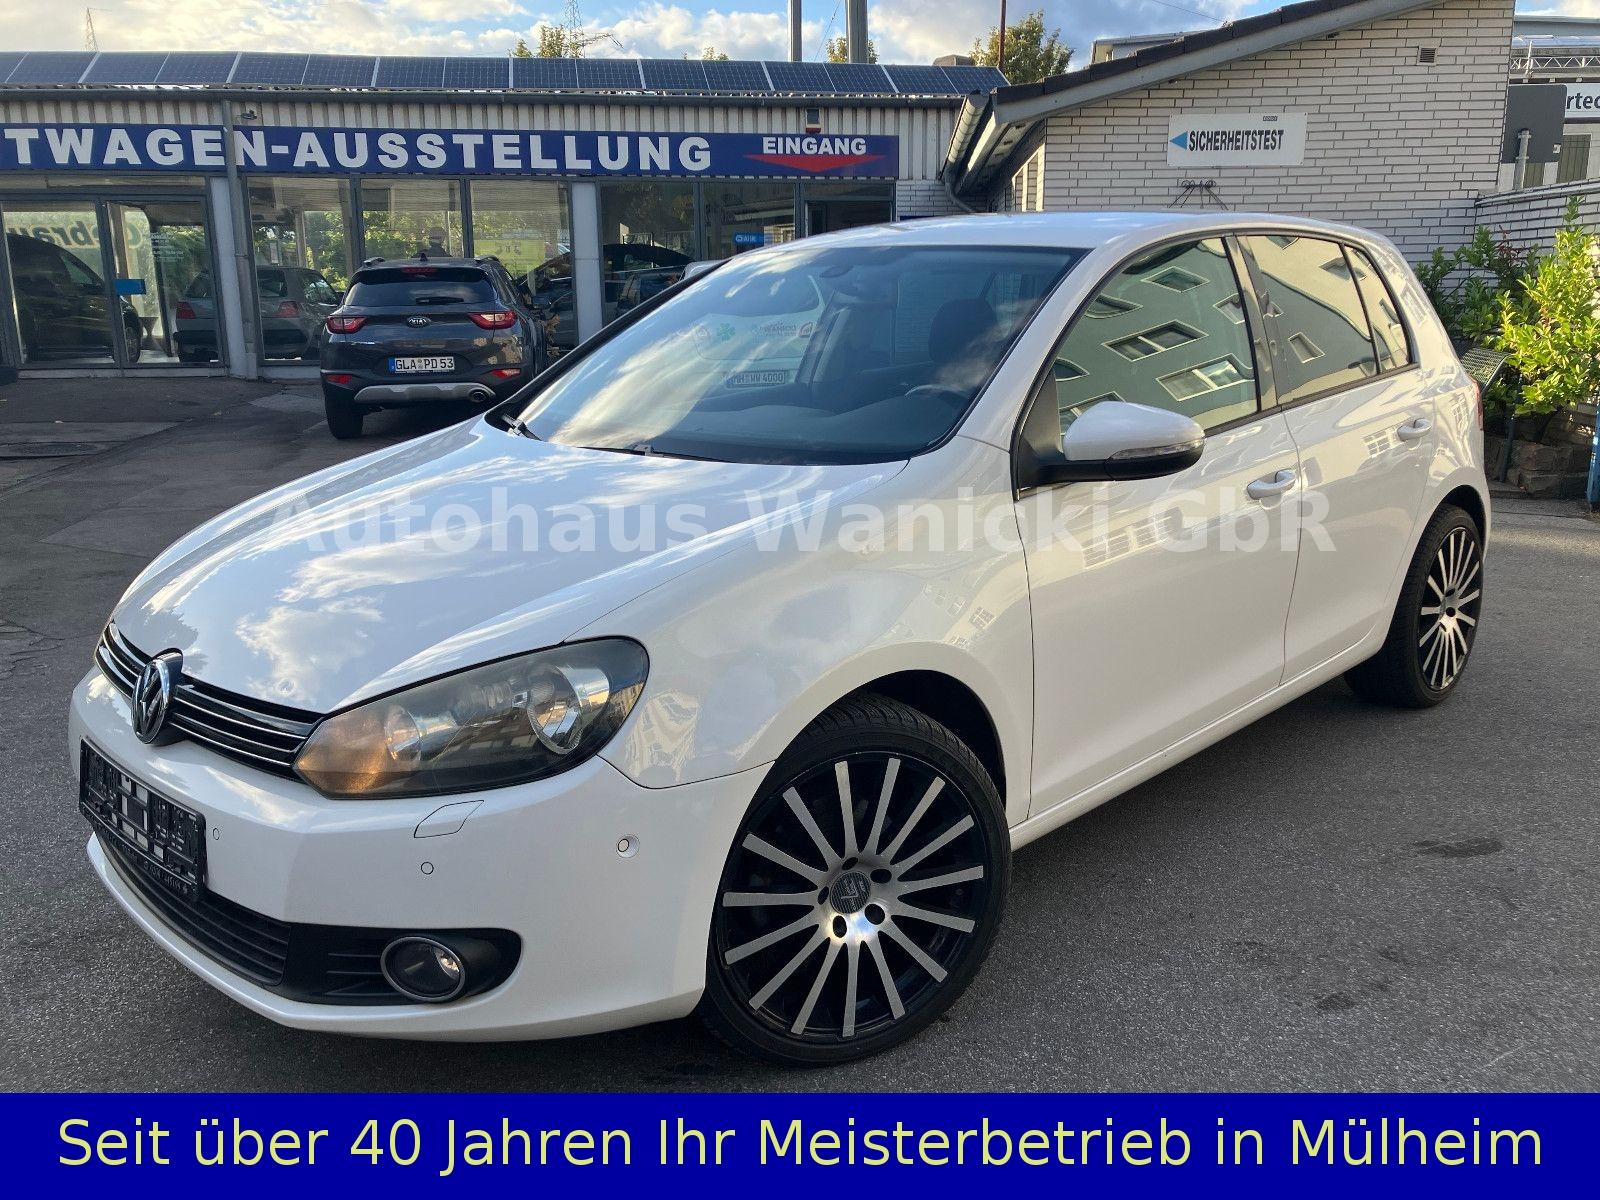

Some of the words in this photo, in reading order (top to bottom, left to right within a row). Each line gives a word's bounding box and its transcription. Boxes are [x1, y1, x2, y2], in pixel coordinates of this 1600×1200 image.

[4, 128, 711, 171] TWAGEN-AUSSTELLUNG
[763, 136, 867, 155] EINGANG
[1189, 129, 1284, 151] SICHERHEITSTEST
[396, 359, 417, 370] GLA
[424, 359, 438, 369] PD
[440, 358, 454, 369] 53
